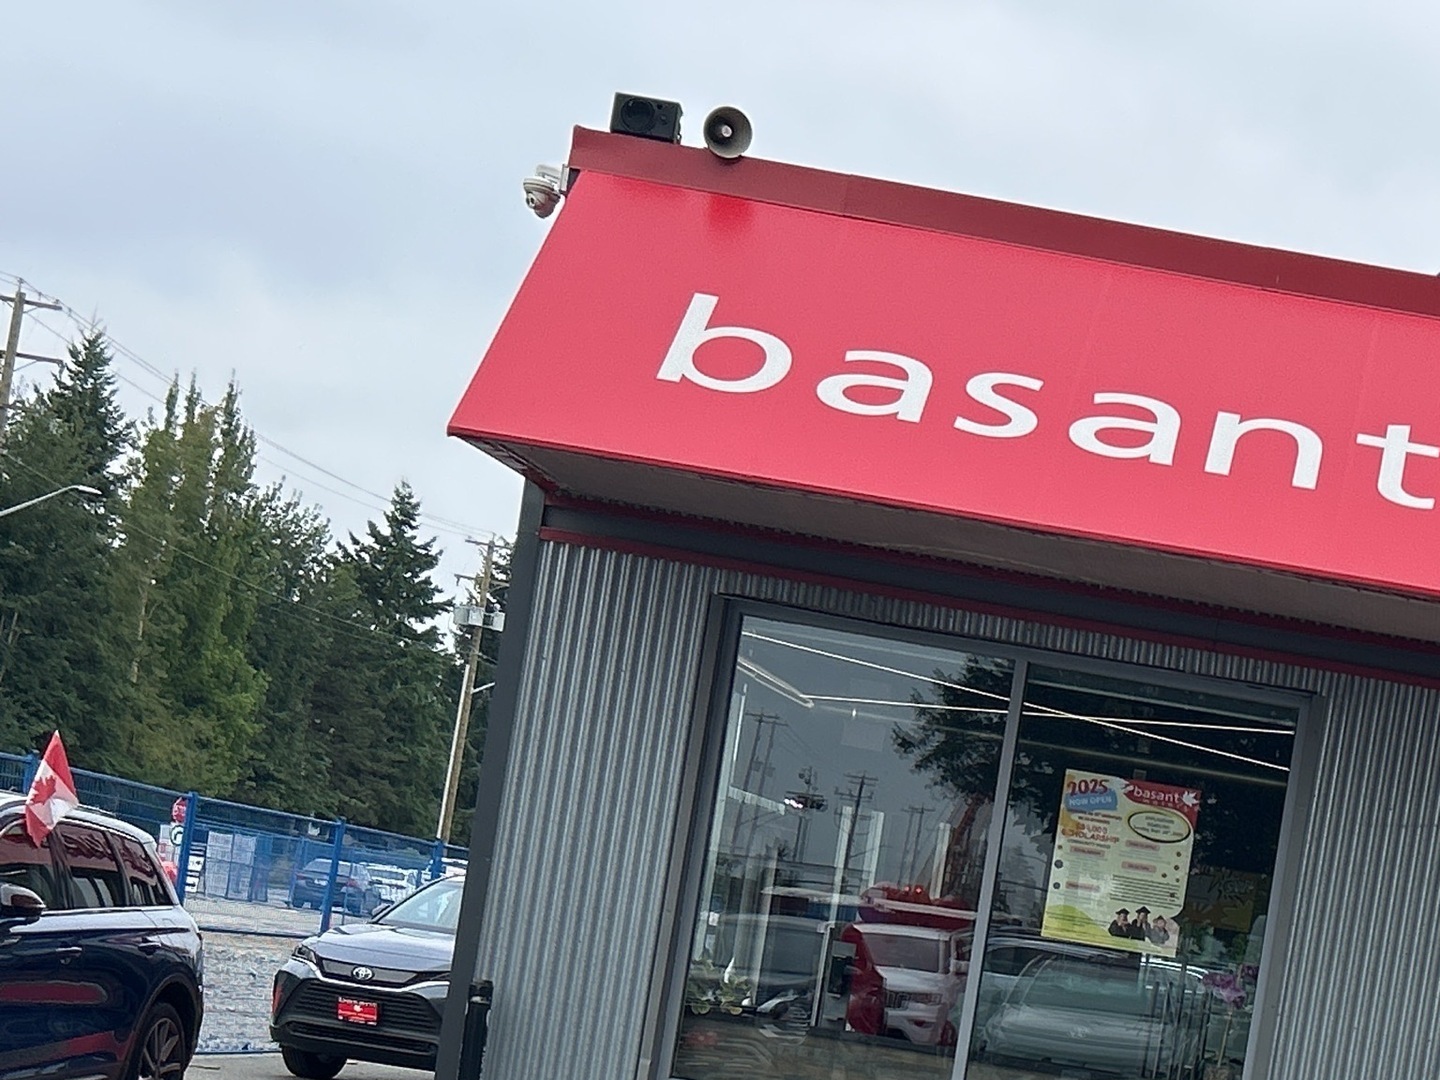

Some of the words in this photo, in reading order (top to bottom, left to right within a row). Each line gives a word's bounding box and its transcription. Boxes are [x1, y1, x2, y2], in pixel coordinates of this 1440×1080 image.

[656, 292, 1440, 510] basant
[1066, 778, 1110, 796] 2025
[1133, 785, 1179, 803] basant
